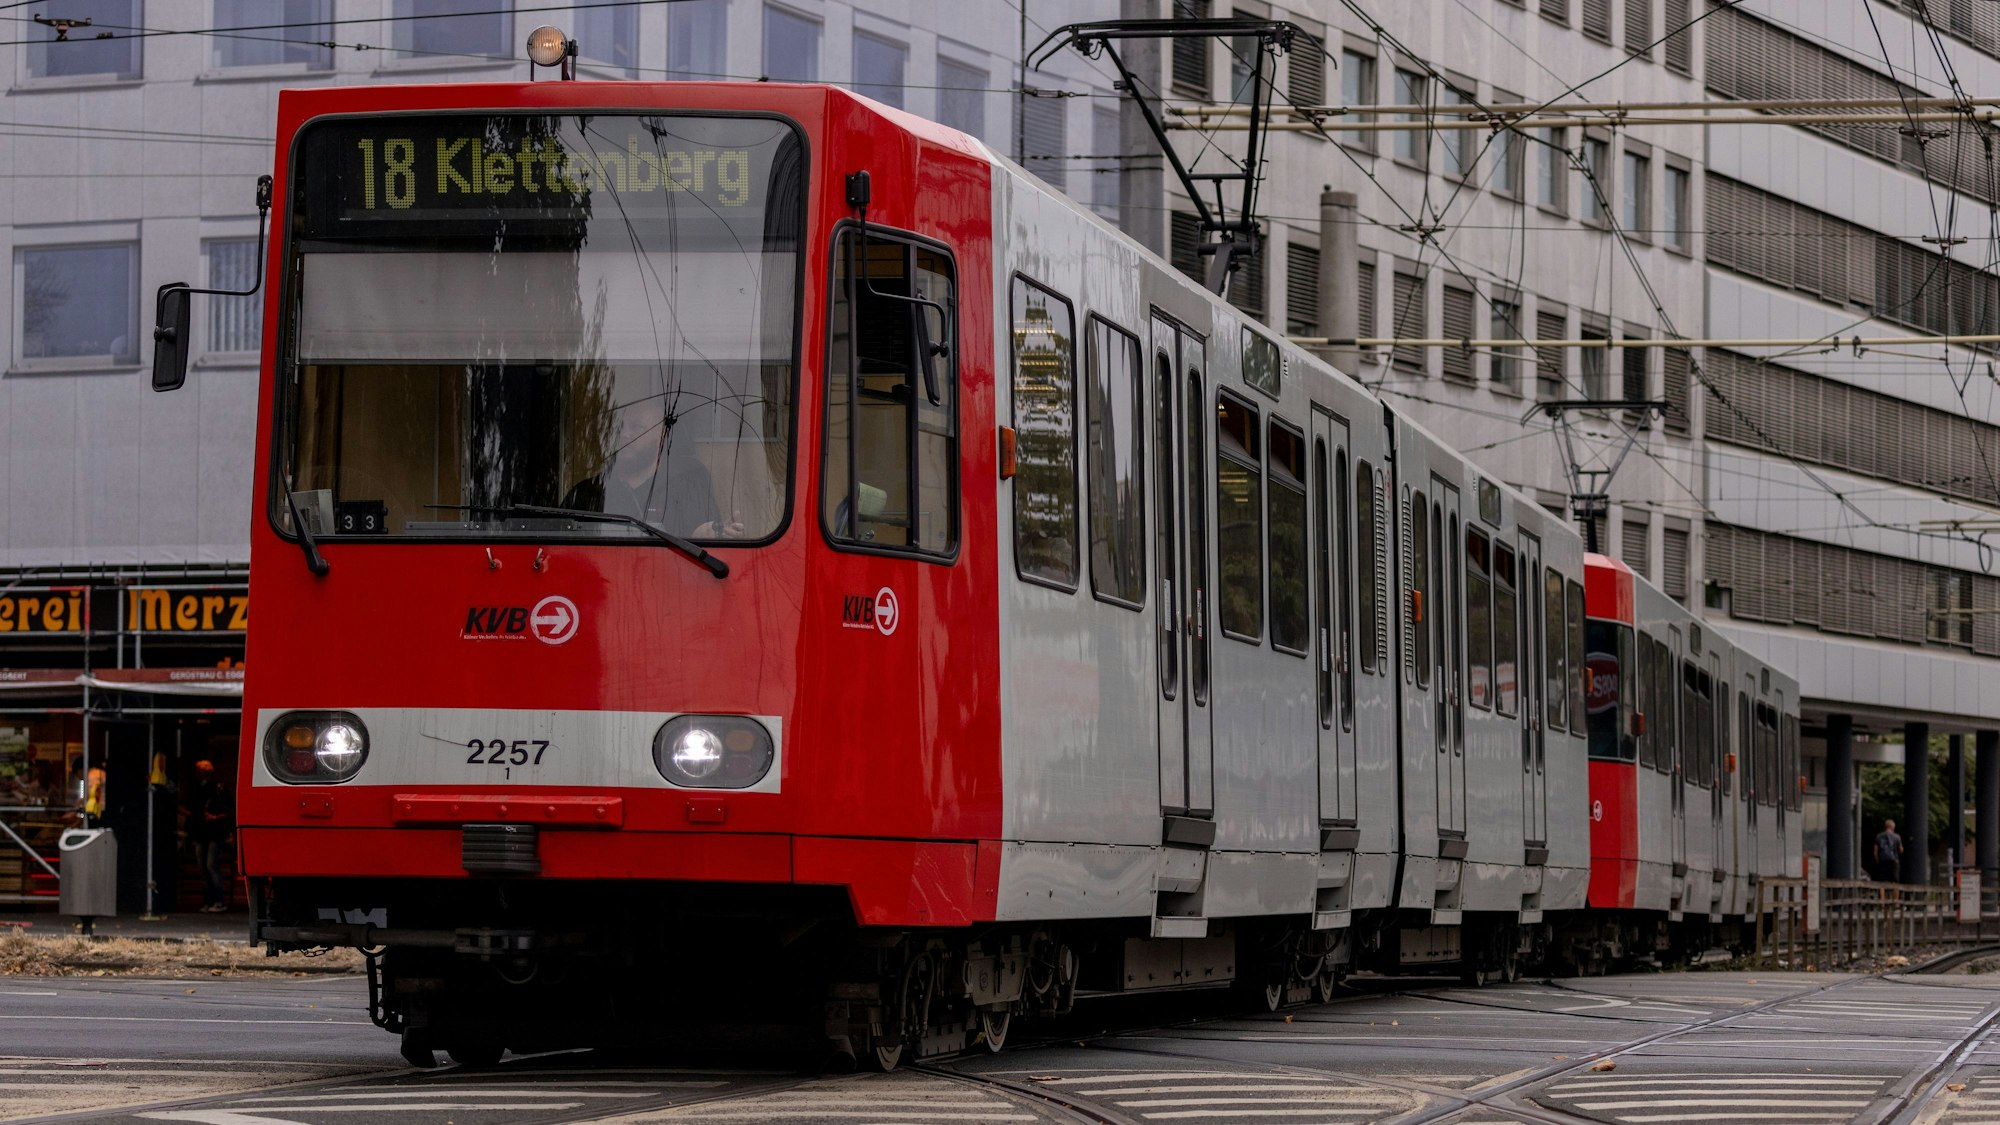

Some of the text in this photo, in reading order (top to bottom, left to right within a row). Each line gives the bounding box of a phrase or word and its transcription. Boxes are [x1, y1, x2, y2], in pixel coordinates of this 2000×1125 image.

[358, 133, 749, 209] 18 Klettenberg
[0, 588, 82, 632] erei
[465, 607, 529, 634] KVB
[842, 595, 875, 623] KVB
[466, 738, 550, 766] 2257
[504, 766, 511, 780] 1
